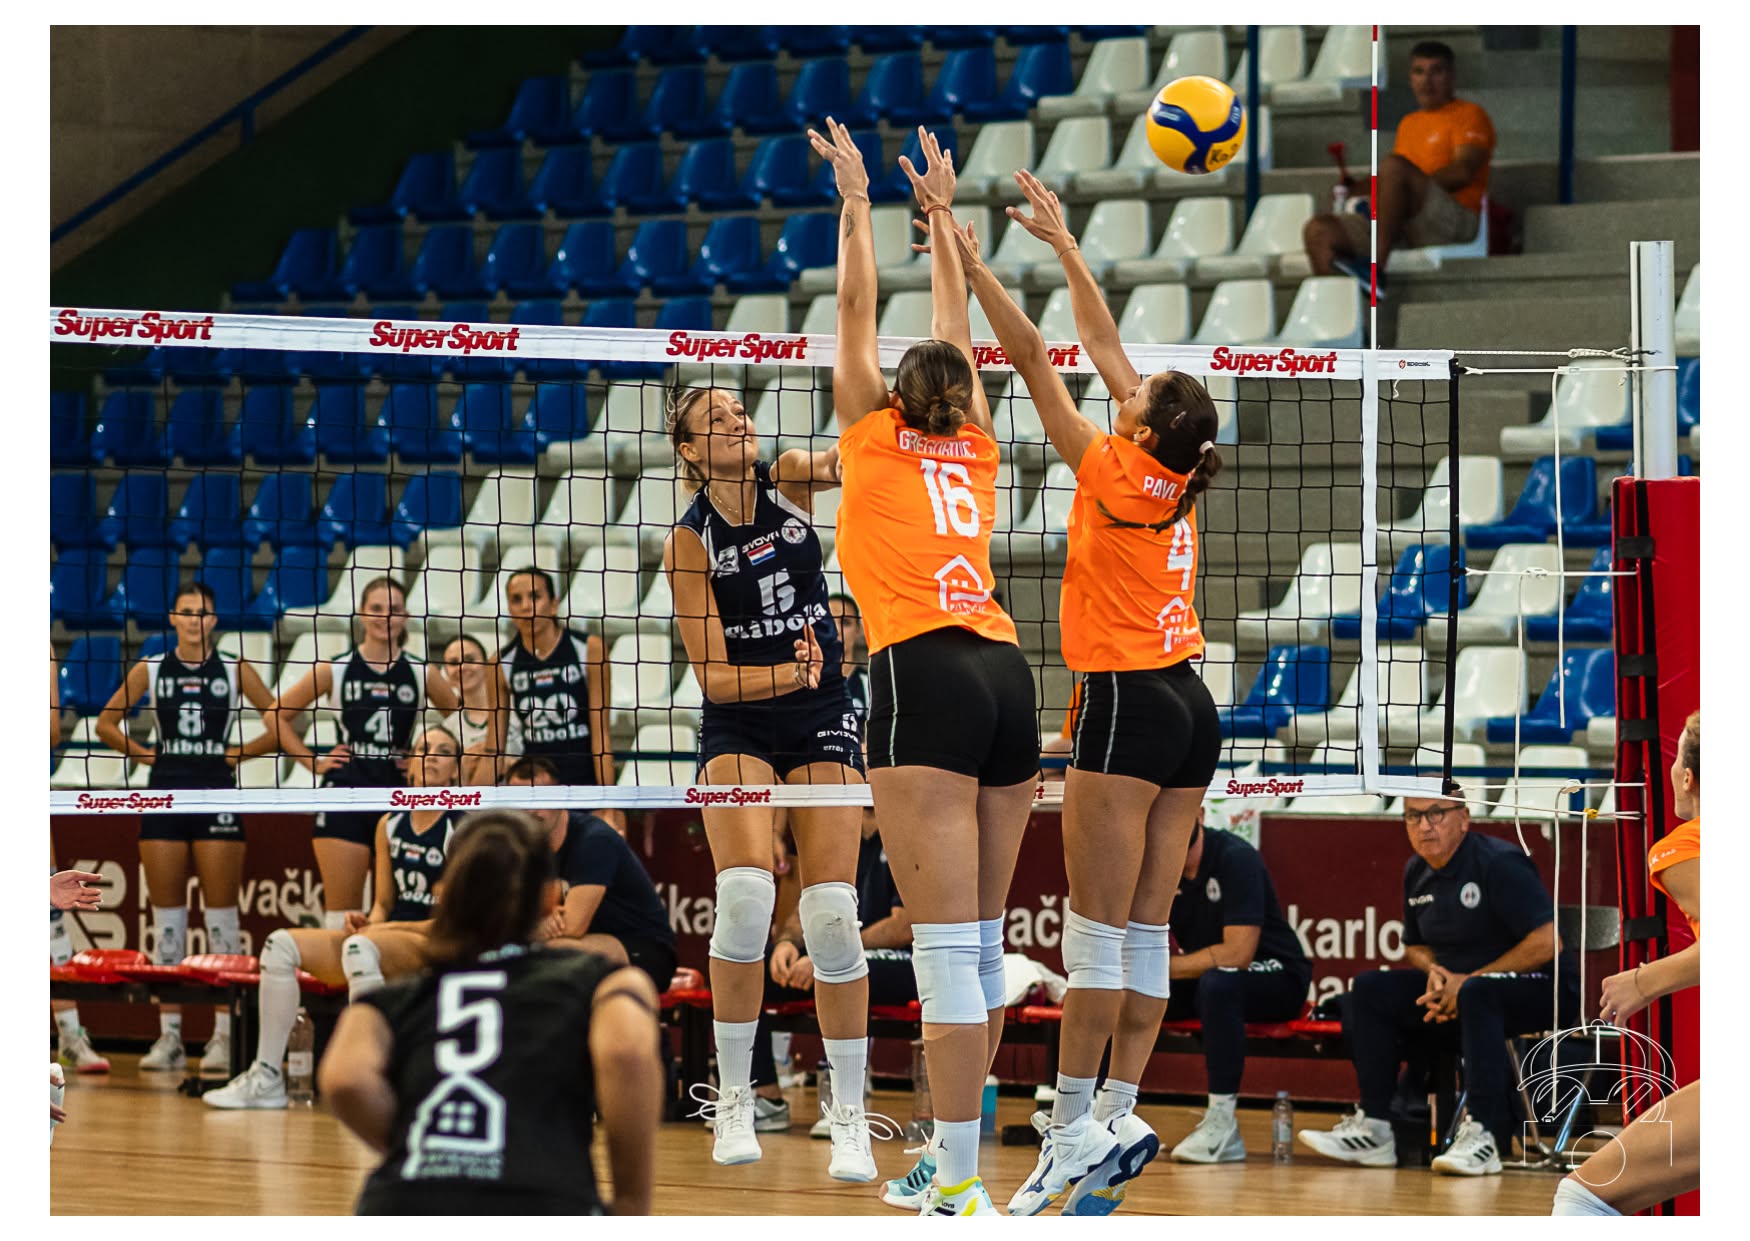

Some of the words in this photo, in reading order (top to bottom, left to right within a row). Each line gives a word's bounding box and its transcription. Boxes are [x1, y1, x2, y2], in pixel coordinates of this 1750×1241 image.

[54, 309, 215, 343] SuperSport
[369, 321, 520, 354] SuperSport
[666, 331, 808, 363] SuperSport
[1210, 346, 1338, 377] SuperSport
[920, 458, 980, 538] 16
[1167, 516, 1194, 591] 4
[177, 700, 206, 737] 8
[364, 706, 394, 742] 4
[519, 692, 579, 728] 20
[76, 793, 174, 812] SuperSport
[390, 790, 482, 809] SuperSport
[685, 787, 772, 806] SuperSport
[1225, 778, 1305, 797] SuperSport
[434, 970, 507, 1075] 5
